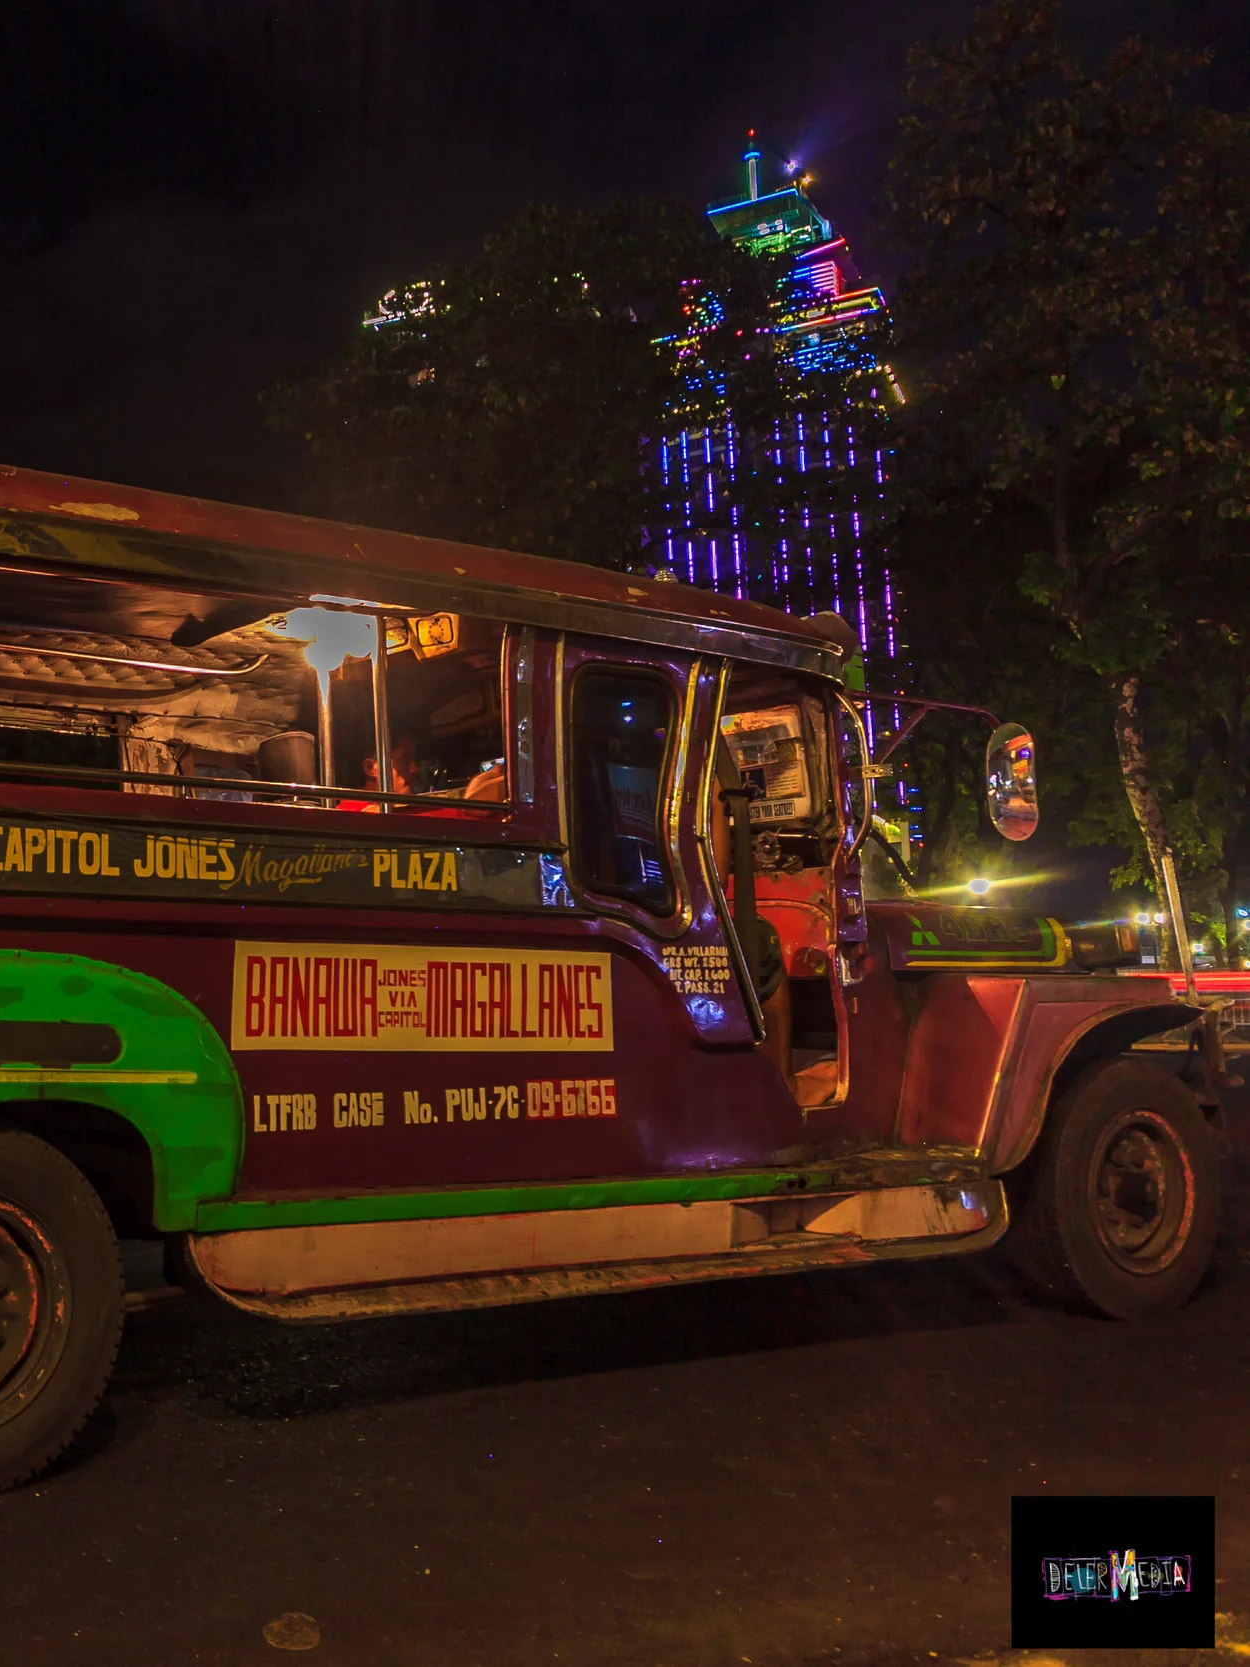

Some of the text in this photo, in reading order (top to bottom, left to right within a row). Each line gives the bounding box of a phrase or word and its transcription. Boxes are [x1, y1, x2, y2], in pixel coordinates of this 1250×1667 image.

[133, 834, 236, 881] JONES
[373, 849, 458, 892] PLAZA
[246, 956, 603, 1039] BANAWA JONES MAGALLANES
[388, 990, 417, 1008] VIA
[378, 1011, 426, 1028] CAPITOL
[253, 1093, 317, 1133] LTFRB
[333, 1092, 385, 1129] CASE
[403, 1090, 438, 1125] No.
